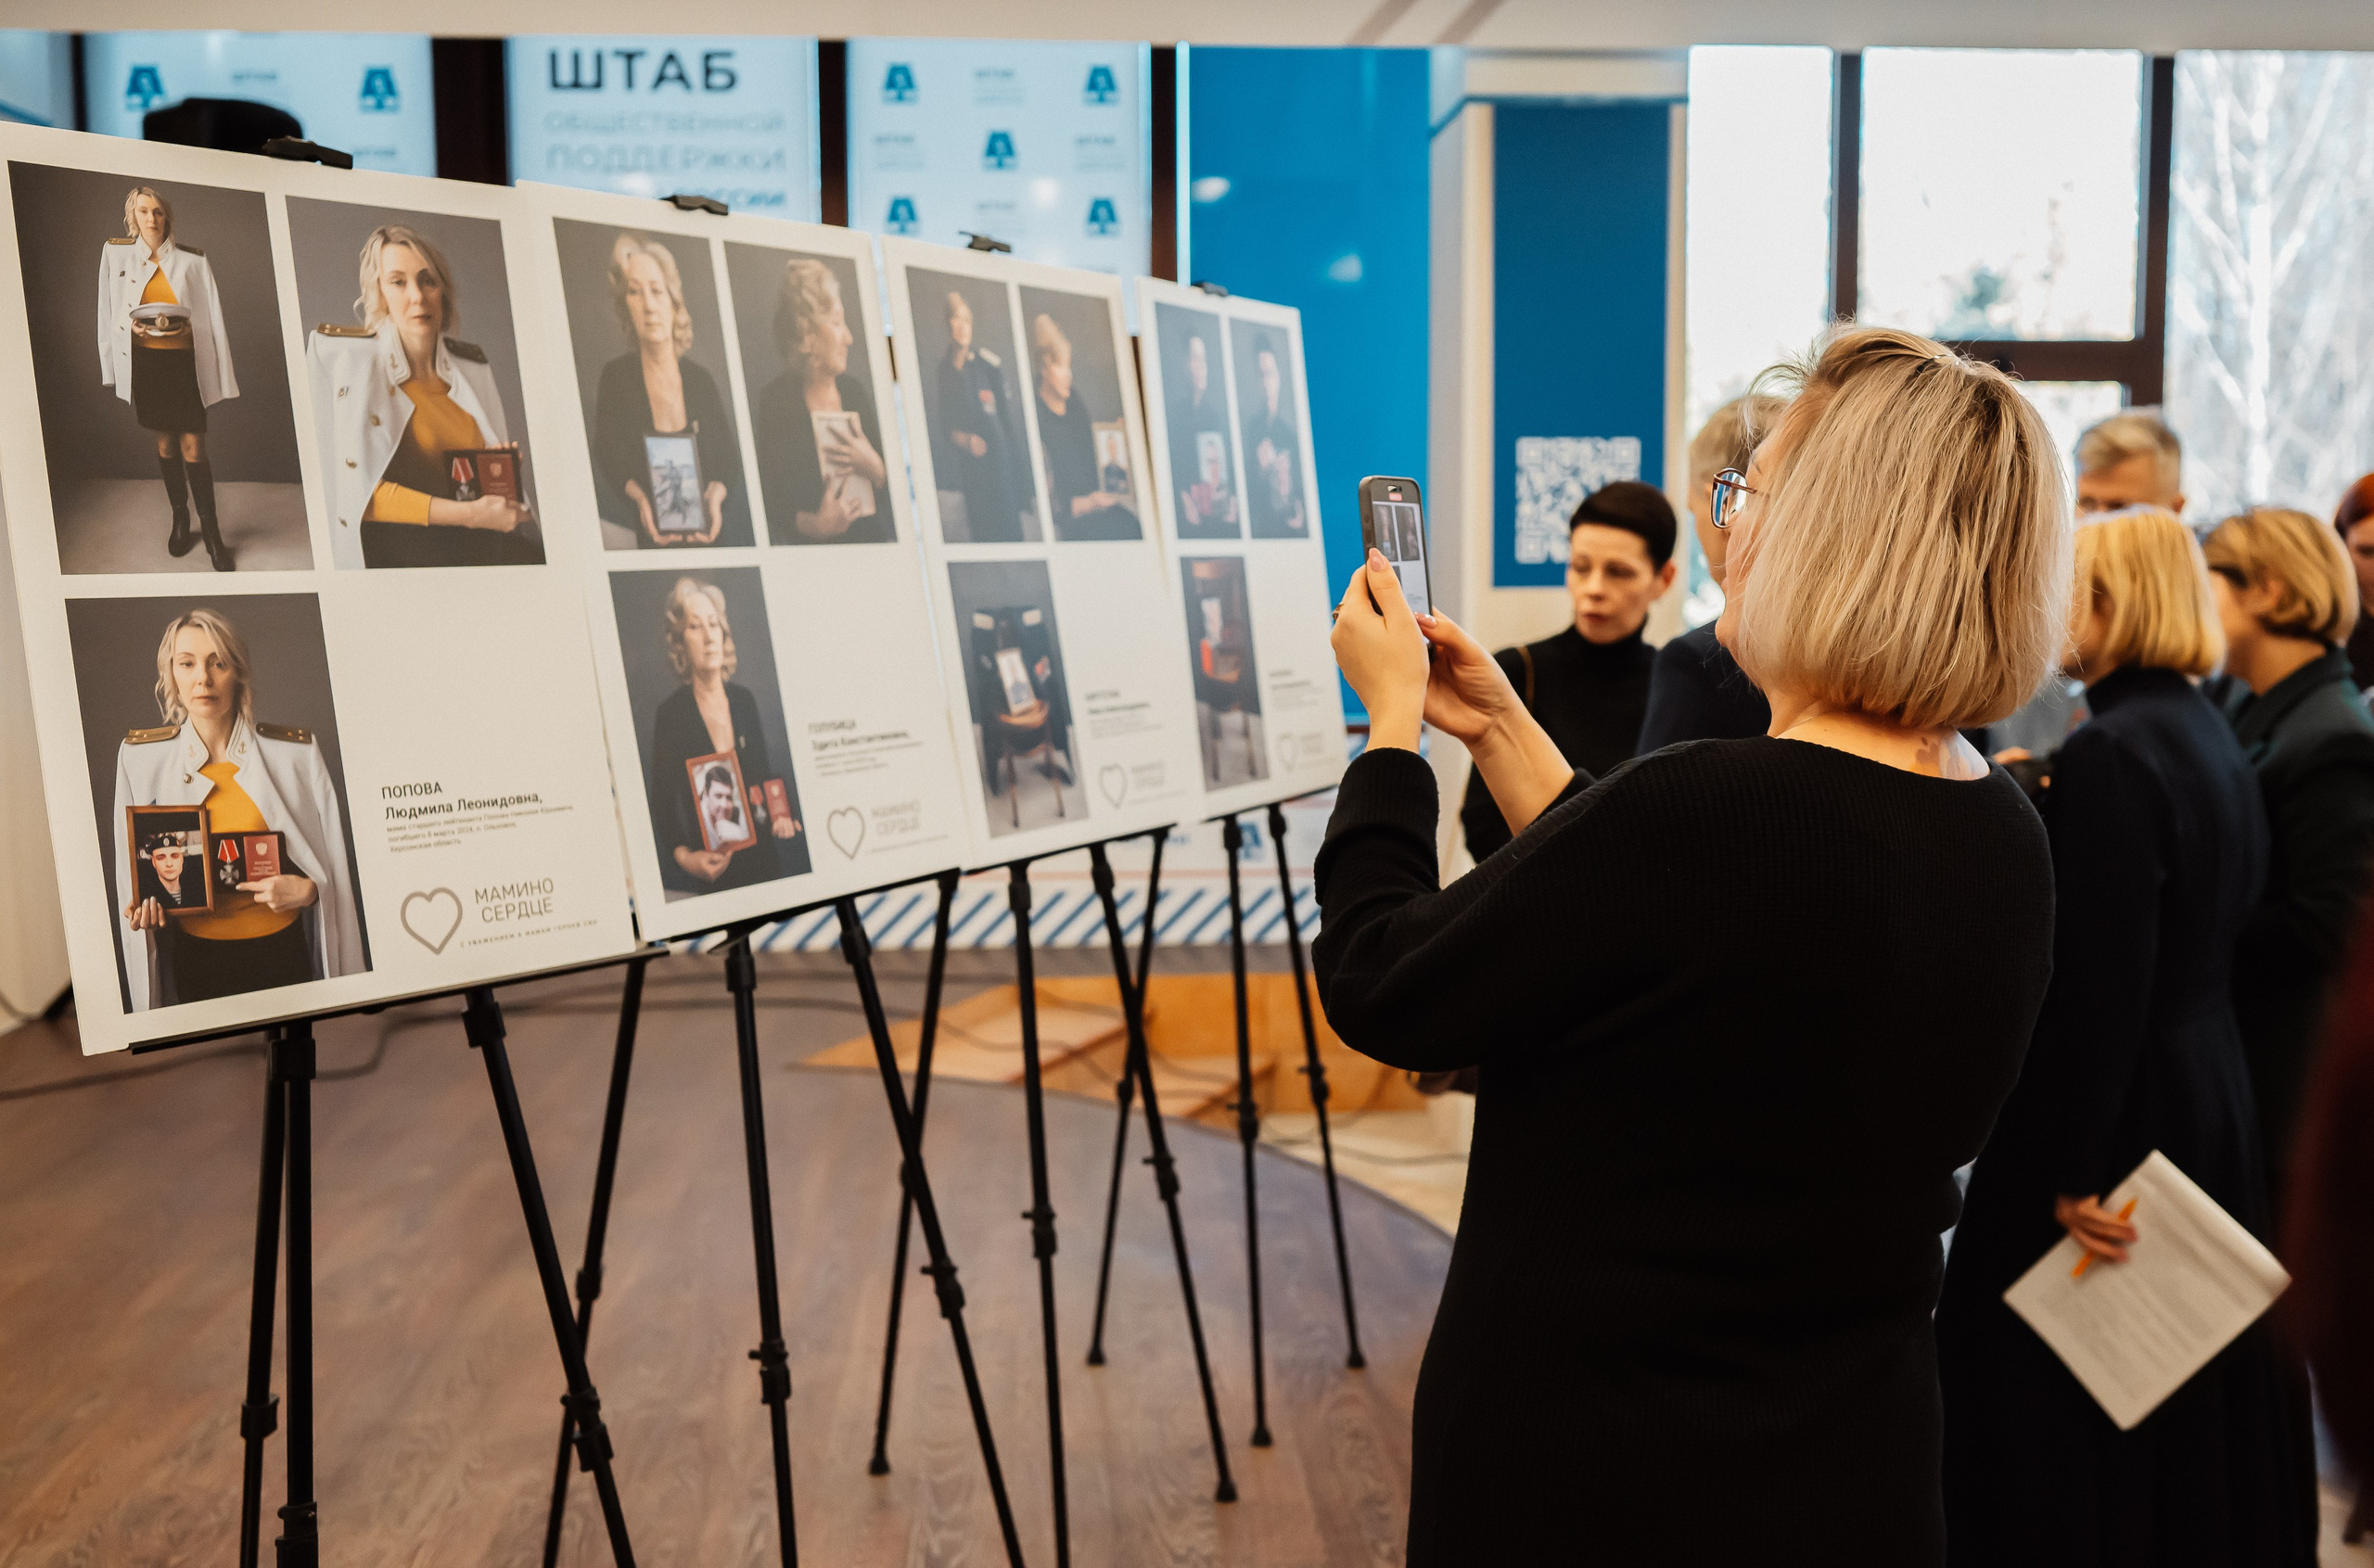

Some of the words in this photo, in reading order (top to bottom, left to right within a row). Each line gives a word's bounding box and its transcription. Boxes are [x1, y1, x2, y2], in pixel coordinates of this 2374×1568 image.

[551, 49, 738, 91] ШТАБ
[381, 781, 442, 799] ПОПОВА
[386, 803, 453, 820] Людмила
[457, 793, 542, 811] Леонидовна,
[474, 876, 555, 904] МАМИНО
[481, 896, 555, 924] СЕРДЦЕ
